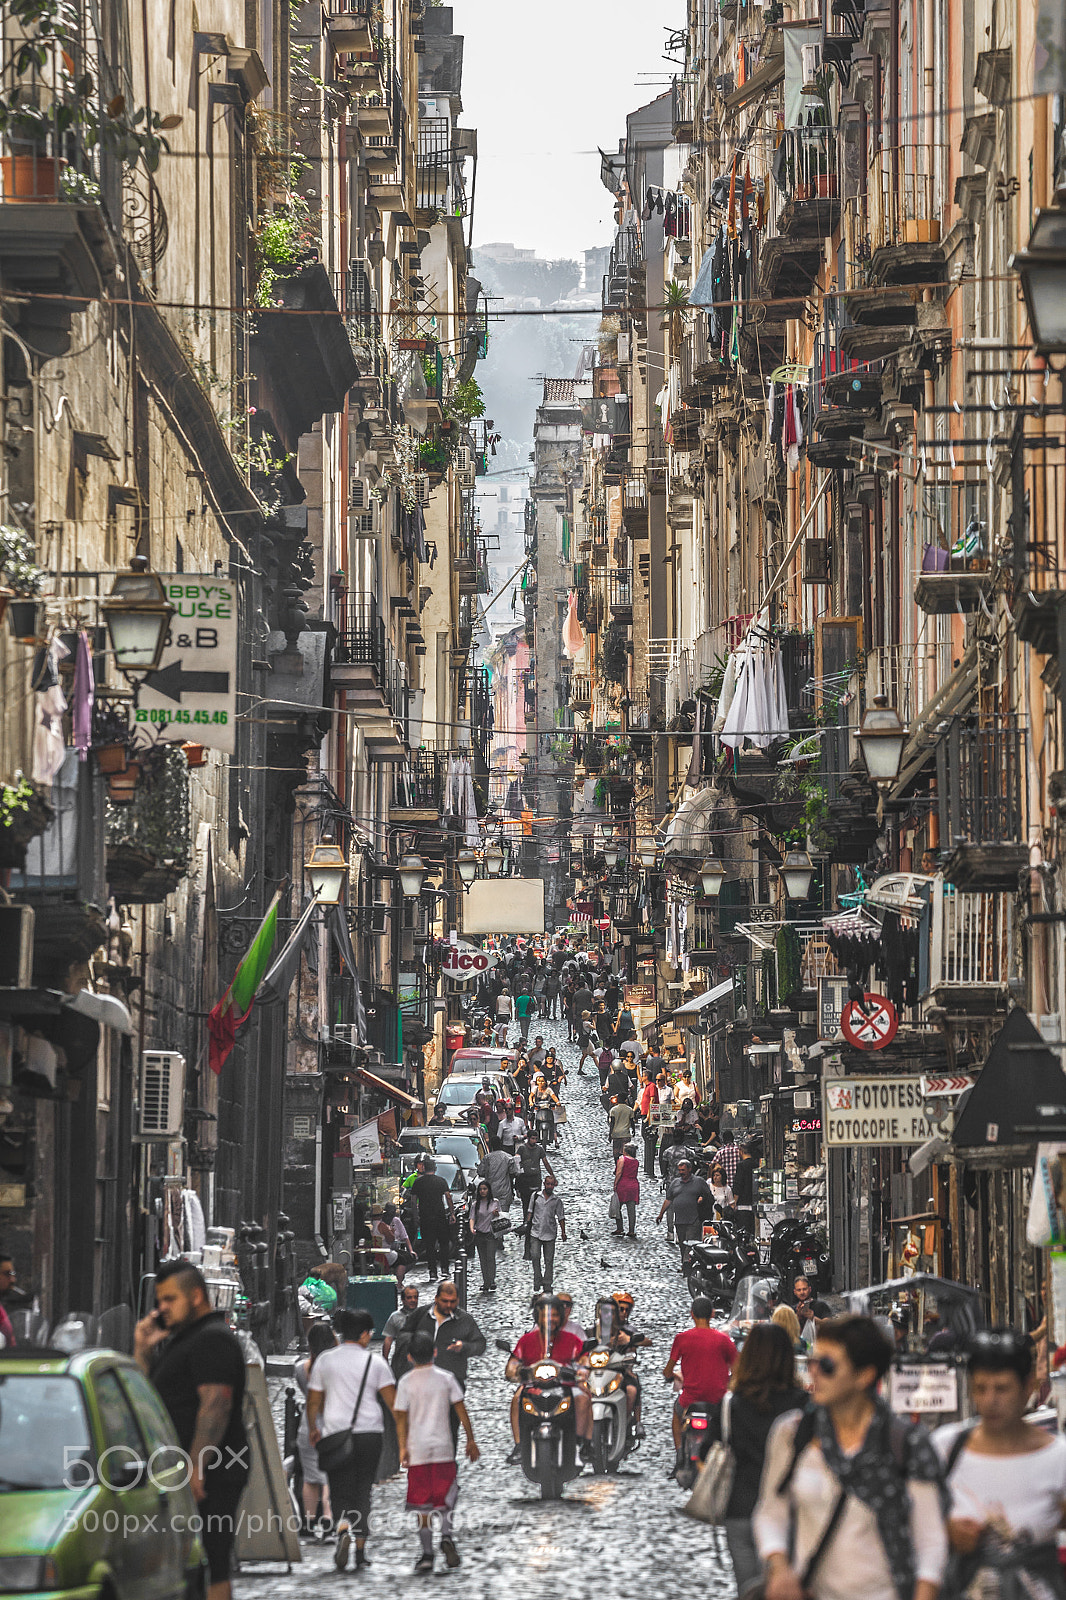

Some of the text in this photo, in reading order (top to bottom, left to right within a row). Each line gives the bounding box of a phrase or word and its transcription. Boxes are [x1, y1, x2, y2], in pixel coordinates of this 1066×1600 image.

[163, 585, 232, 601] BBY'S
[171, 602, 231, 619] USE
[829, 1118, 898, 1140] FOTOCOPIE
[912, 1118, 934, 1137] FAX
